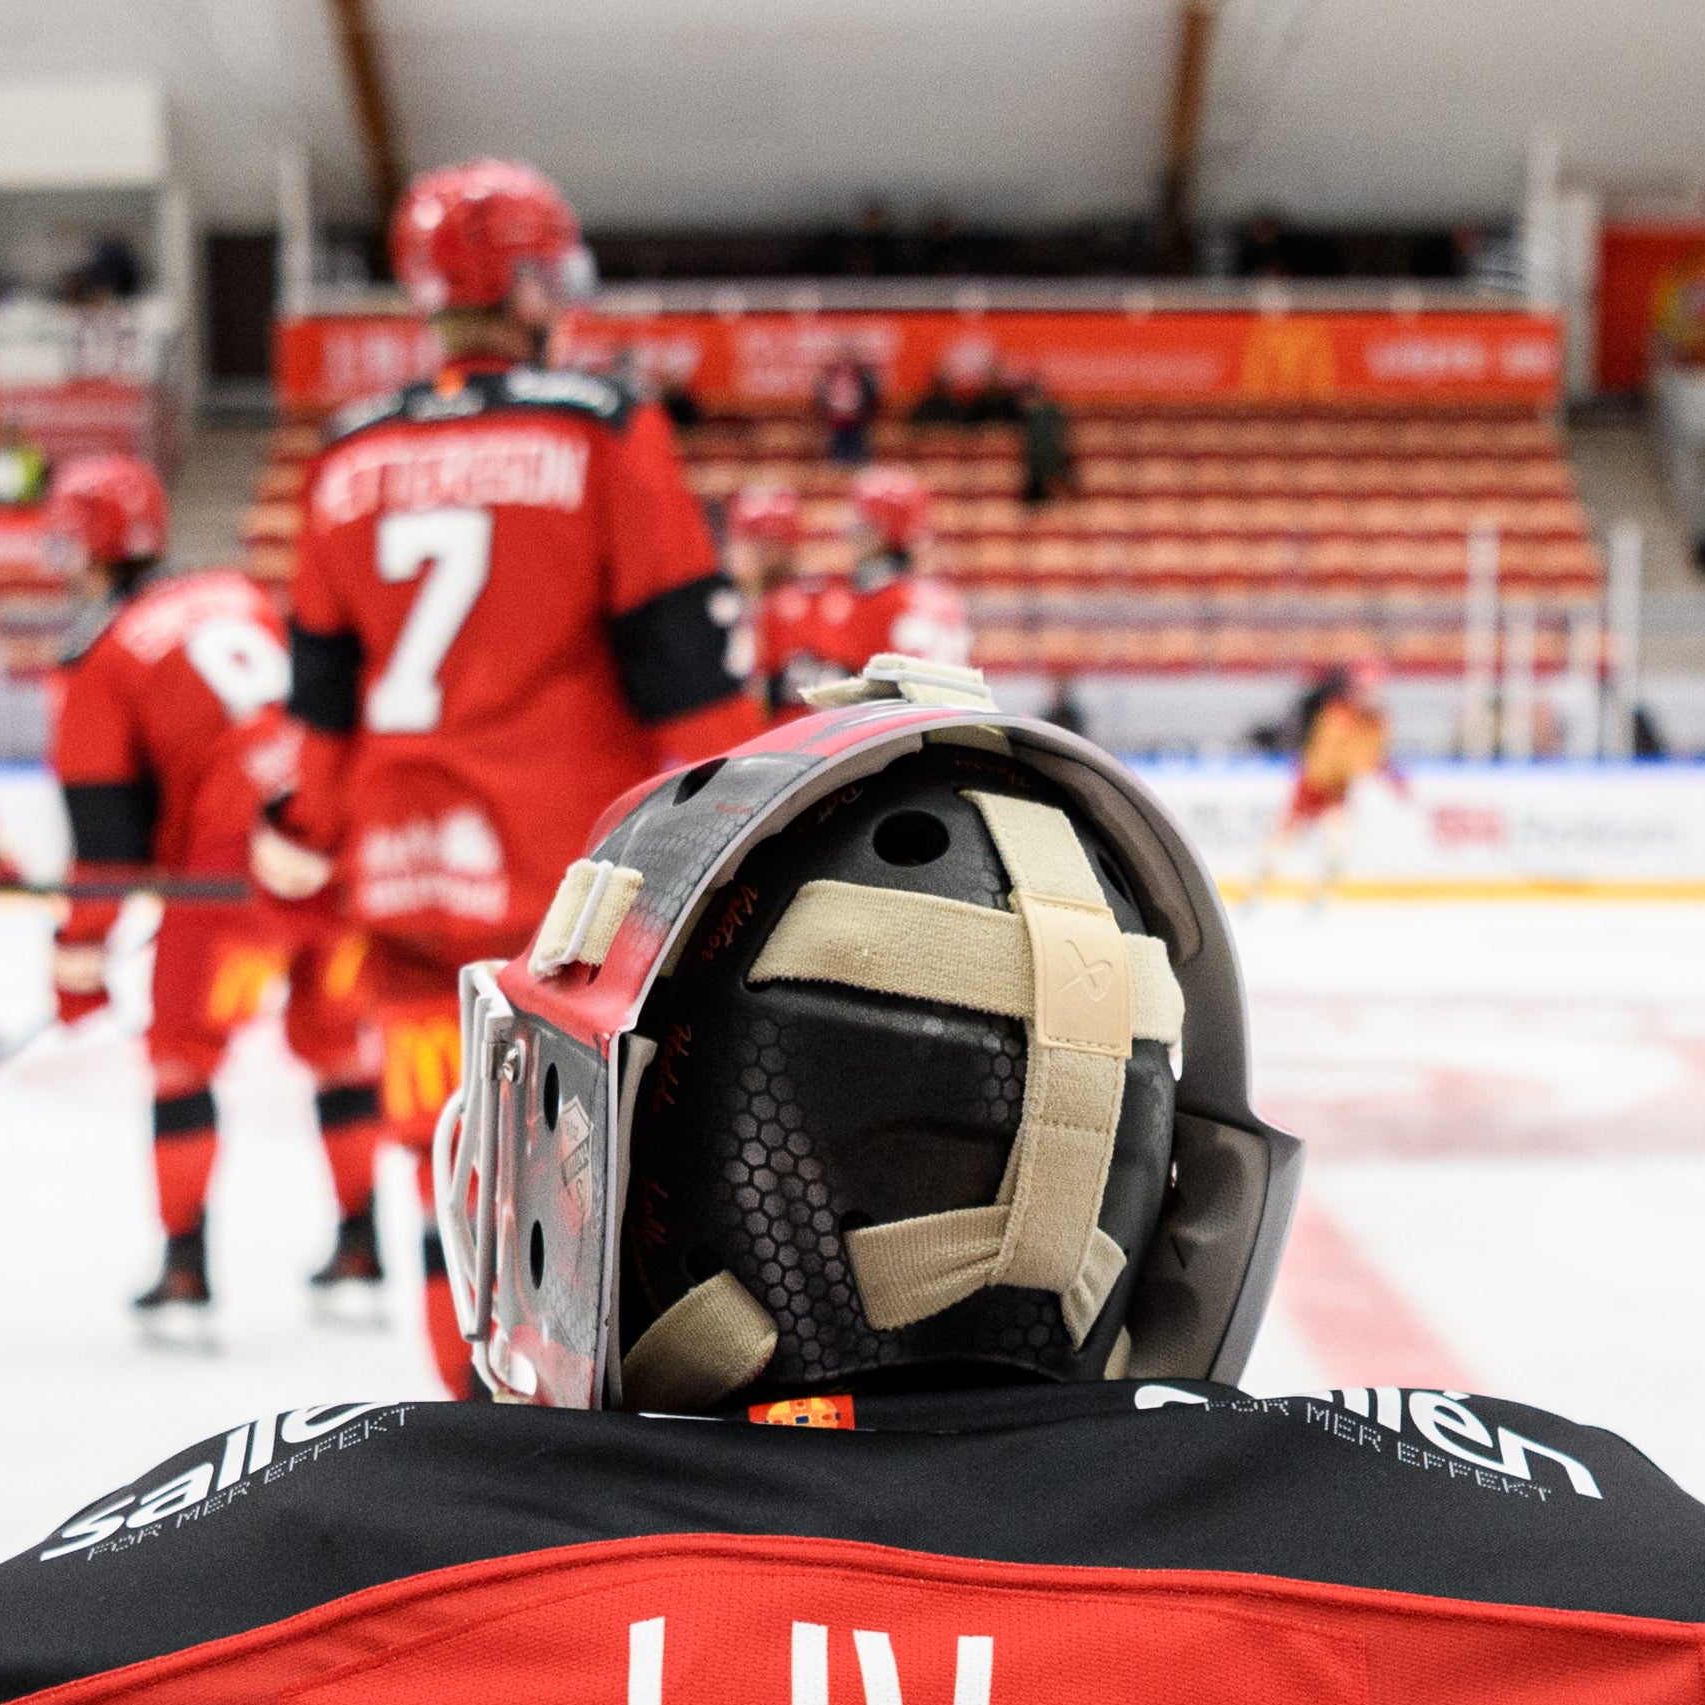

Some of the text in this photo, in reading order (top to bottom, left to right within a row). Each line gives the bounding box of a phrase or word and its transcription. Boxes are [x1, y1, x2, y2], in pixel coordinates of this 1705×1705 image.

[365, 506, 495, 735] 7
[176, 1482, 252, 1529] MER
[263, 1405, 417, 1485] EFFEKT
[1306, 1402, 1381, 1453] MER
[1397, 1440, 1553, 1502] EFFEKT
